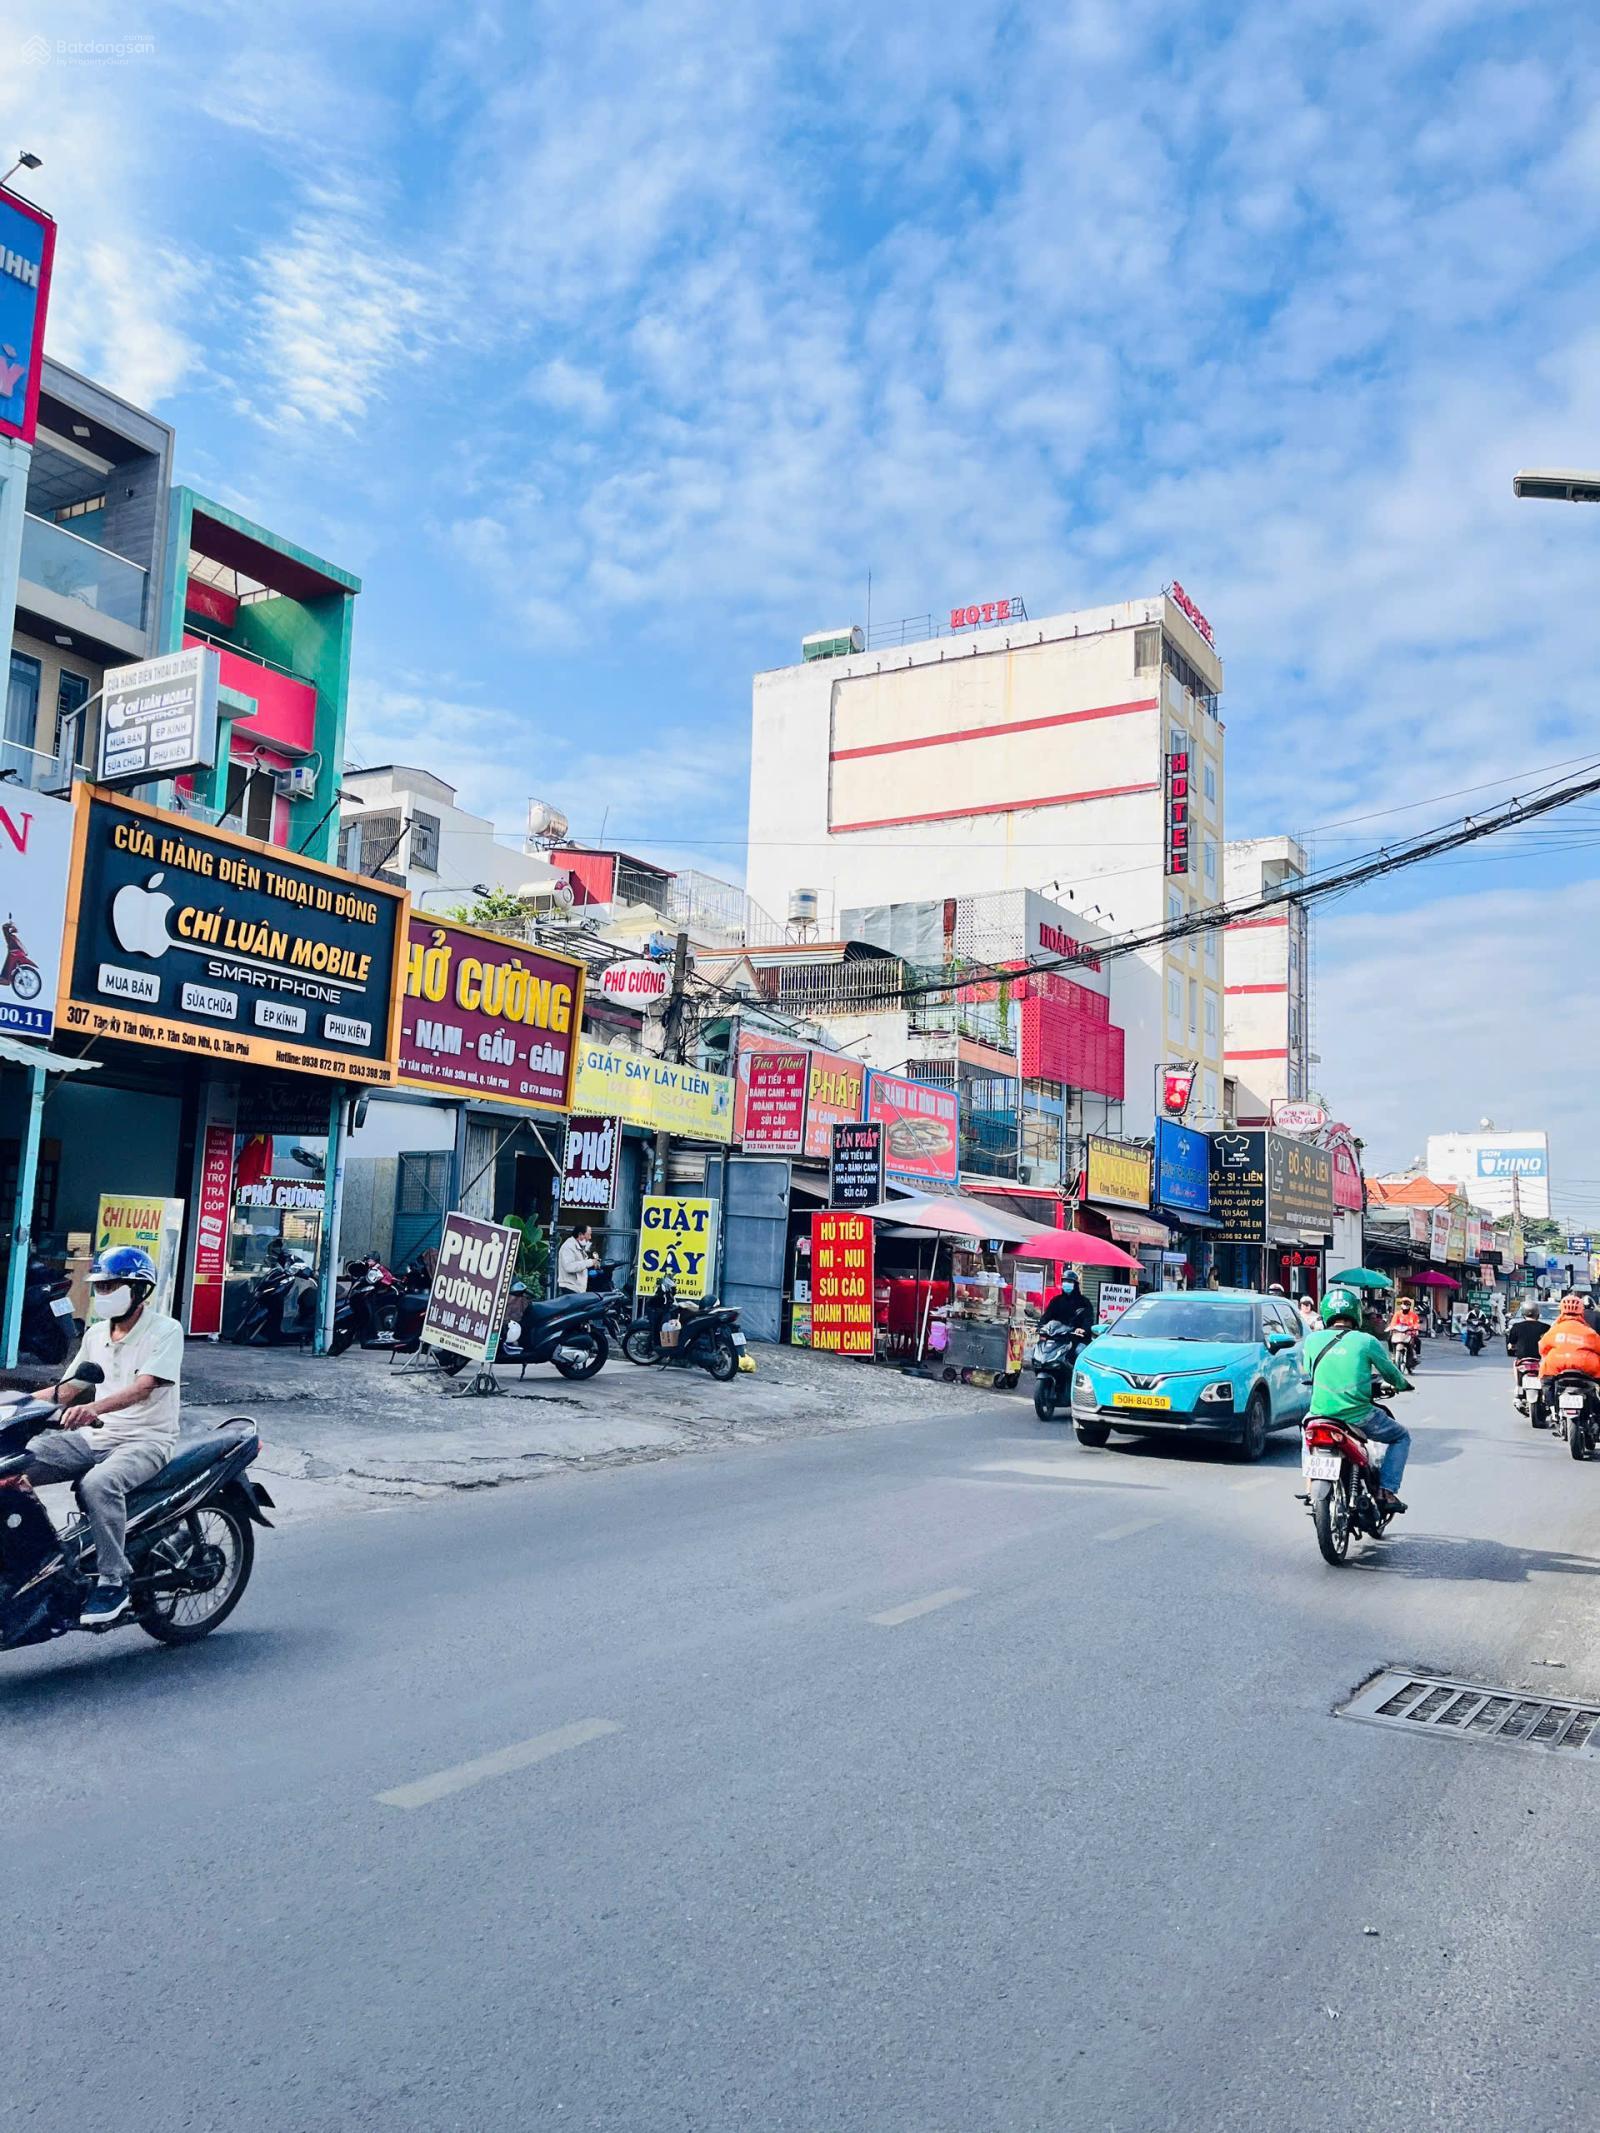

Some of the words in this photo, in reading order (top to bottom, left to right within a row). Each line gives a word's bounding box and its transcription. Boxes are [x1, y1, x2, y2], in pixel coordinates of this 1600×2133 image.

[161, 687, 193, 707] MOBILE
[134, 707, 185, 725] SMARTPHONE
[109, 736, 125, 748] MUA
[1172, 753, 1187, 872] HOTEL
[114, 820, 155, 858] CỬA
[161, 838, 213, 877] HÀNG
[219, 858, 261, 891] ĐIỆN
[265, 871, 314, 910] THOẠI
[317, 886, 334, 908] DI
[335, 891, 378, 925] ĐỘNG
[177, 906, 225, 945] CHÍ
[224, 919, 288, 960] LUÂN
[290, 936, 373, 982] MOBILE
[105, 974, 128, 992] MUA
[208, 961, 342, 1005] SMARTPHONE
[604, 965, 627, 992] PHỞ
[628, 966, 666, 993] CƯỜNG
[186, 989, 205, 1010] SỬA
[207, 997, 233, 1015] CHỮA
[456, 957, 573, 1034] CƯỜNG
[67, 1005, 90, 1026] 307
[123, 1021, 137, 1035] Tân
[157, 1028, 164, 1040] P.
[167, 1030, 180, 1043] Tân
[182, 1033, 196, 1046] Sơn
[214, 1039, 221, 1051] Q.
[222, 1040, 235, 1053] Tân
[329, 1021, 346, 1038] PHỤ
[348, 1024, 367, 1042] KIỆN
[415, 1019, 463, 1057] NẠM
[529, 1042, 565, 1077] GÂN
[276, 1050, 301, 1066] Hotline:
[302, 1055, 319, 1068] 0938
[319, 1058, 332, 1071] 872
[333, 1061, 346, 1073] 873
[349, 1064, 366, 1075] 0343
[587, 1051, 622, 1077] GIẶT
[768, 1088, 785, 1097] CANH
[791, 1088, 802, 1097] NUI
[809, 1069, 861, 1111] PHÁT
[567, 1119, 614, 1172] PHỞ
[836, 1126, 853, 1148] TẤN
[855, 1128, 879, 1147] PHÁT
[210, 1159, 224, 1171] HỖ
[850, 1149, 864, 1160] TIẾU
[865, 1149, 872, 1159] MÌ
[863, 1163, 878, 1171] CANH
[1288, 1147, 1299, 1176] ĐỒ
[1304, 1156, 1311, 1178] SI
[1497, 1158, 1541, 1171] HINO
[207, 1173, 227, 1185] TRỢ
[565, 1172, 609, 1204] CƯỜNG
[1227, 1172, 1235, 1181] SI
[1243, 1170, 1263, 1182] LIÊN
[204, 1199, 225, 1211] GÓP
[241, 1180, 274, 1205] PHỞ
[275, 1183, 325, 1209] CƯỜNG
[643, 1201, 709, 1237] GIẶT
[1232, 1209, 1248, 1217] SÁCH
[1251, 1220, 1262, 1228] EM
[135, 1231, 158, 1241] MOBILE
[821, 1216, 835, 1240] HỦ
[839, 1216, 863, 1240] TIẾU
[441, 1230, 504, 1280] PHỞ
[642, 1241, 705, 1275] SẤY
[820, 1246, 833, 1268] MÌ
[844, 1249, 865, 1268] NUI
[434, 1275, 493, 1316] CƯỜNG
[494, 1297, 505, 1331] PHỞ
[502, 1238, 518, 1294] CƯỜNG
[820, 1272, 838, 1297] SỦI
[842, 1272, 865, 1297] CẢO
[813, 1300, 841, 1322] HOÀNH
[844, 1300, 871, 1322] THÁNH
[813, 1326, 841, 1349] BÁNH
[843, 1331, 871, 1350] CANH
